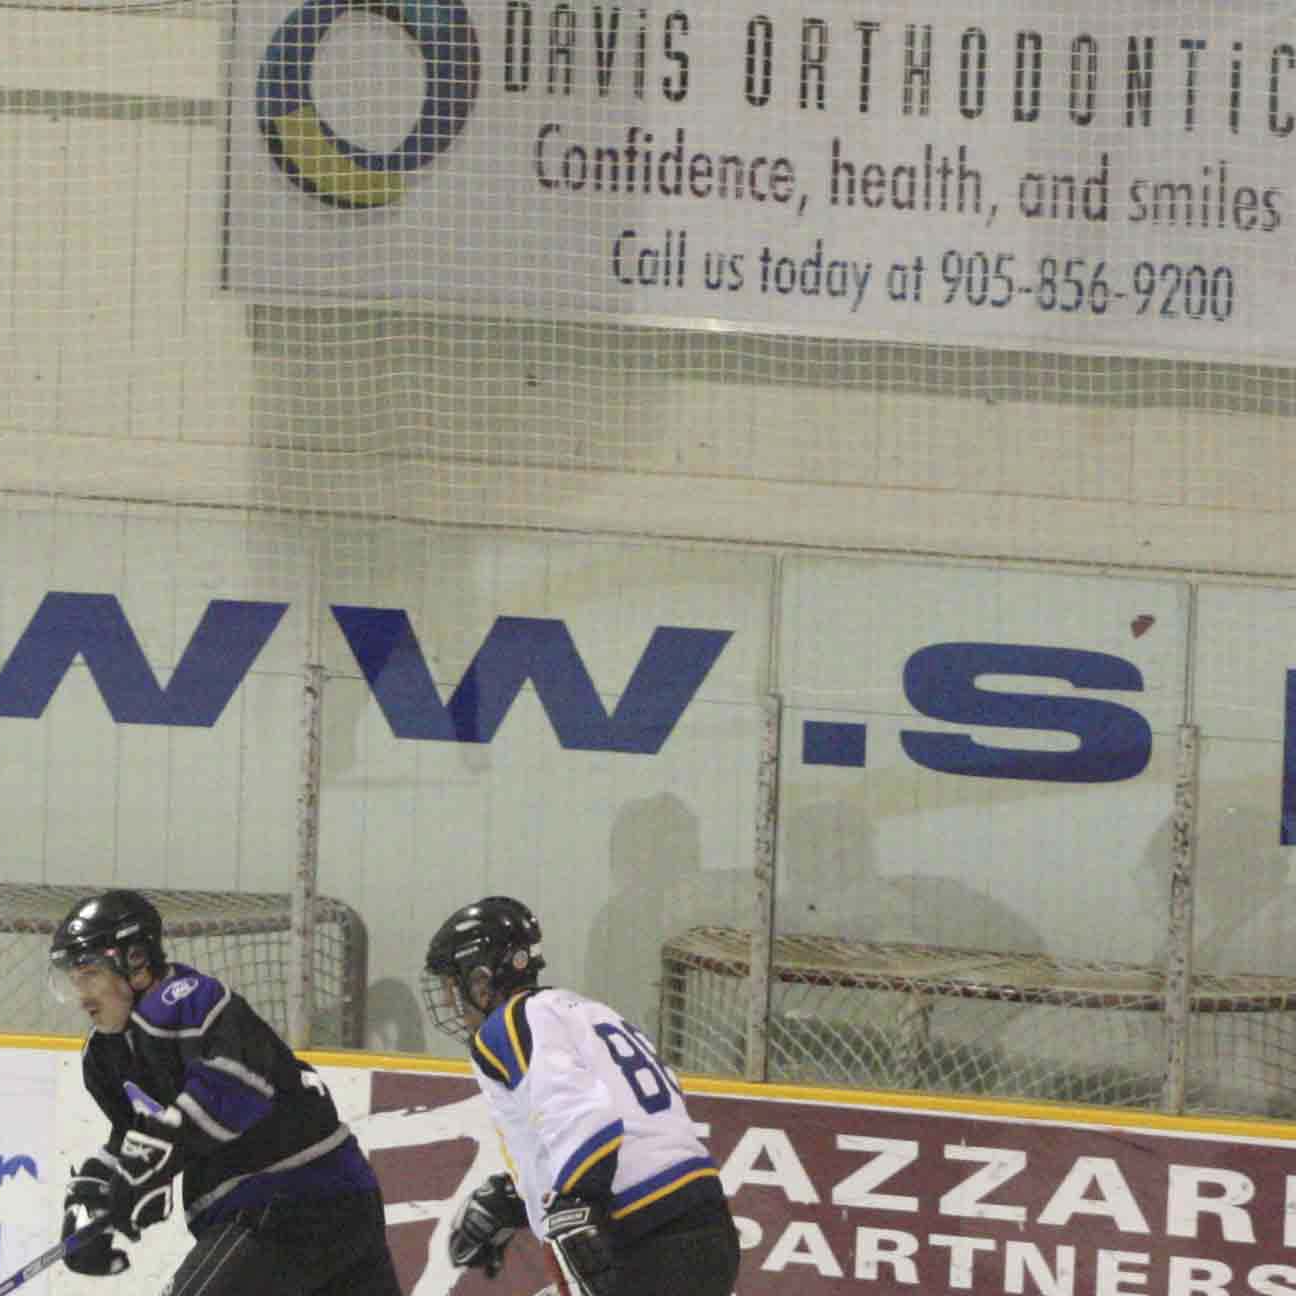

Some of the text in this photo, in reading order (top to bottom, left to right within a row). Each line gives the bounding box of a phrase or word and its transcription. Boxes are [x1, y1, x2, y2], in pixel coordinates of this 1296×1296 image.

[533, 122, 1282, 232] Confidence, health, and smiles
[612, 228, 1235, 322] Call us today at 905-856-9200
